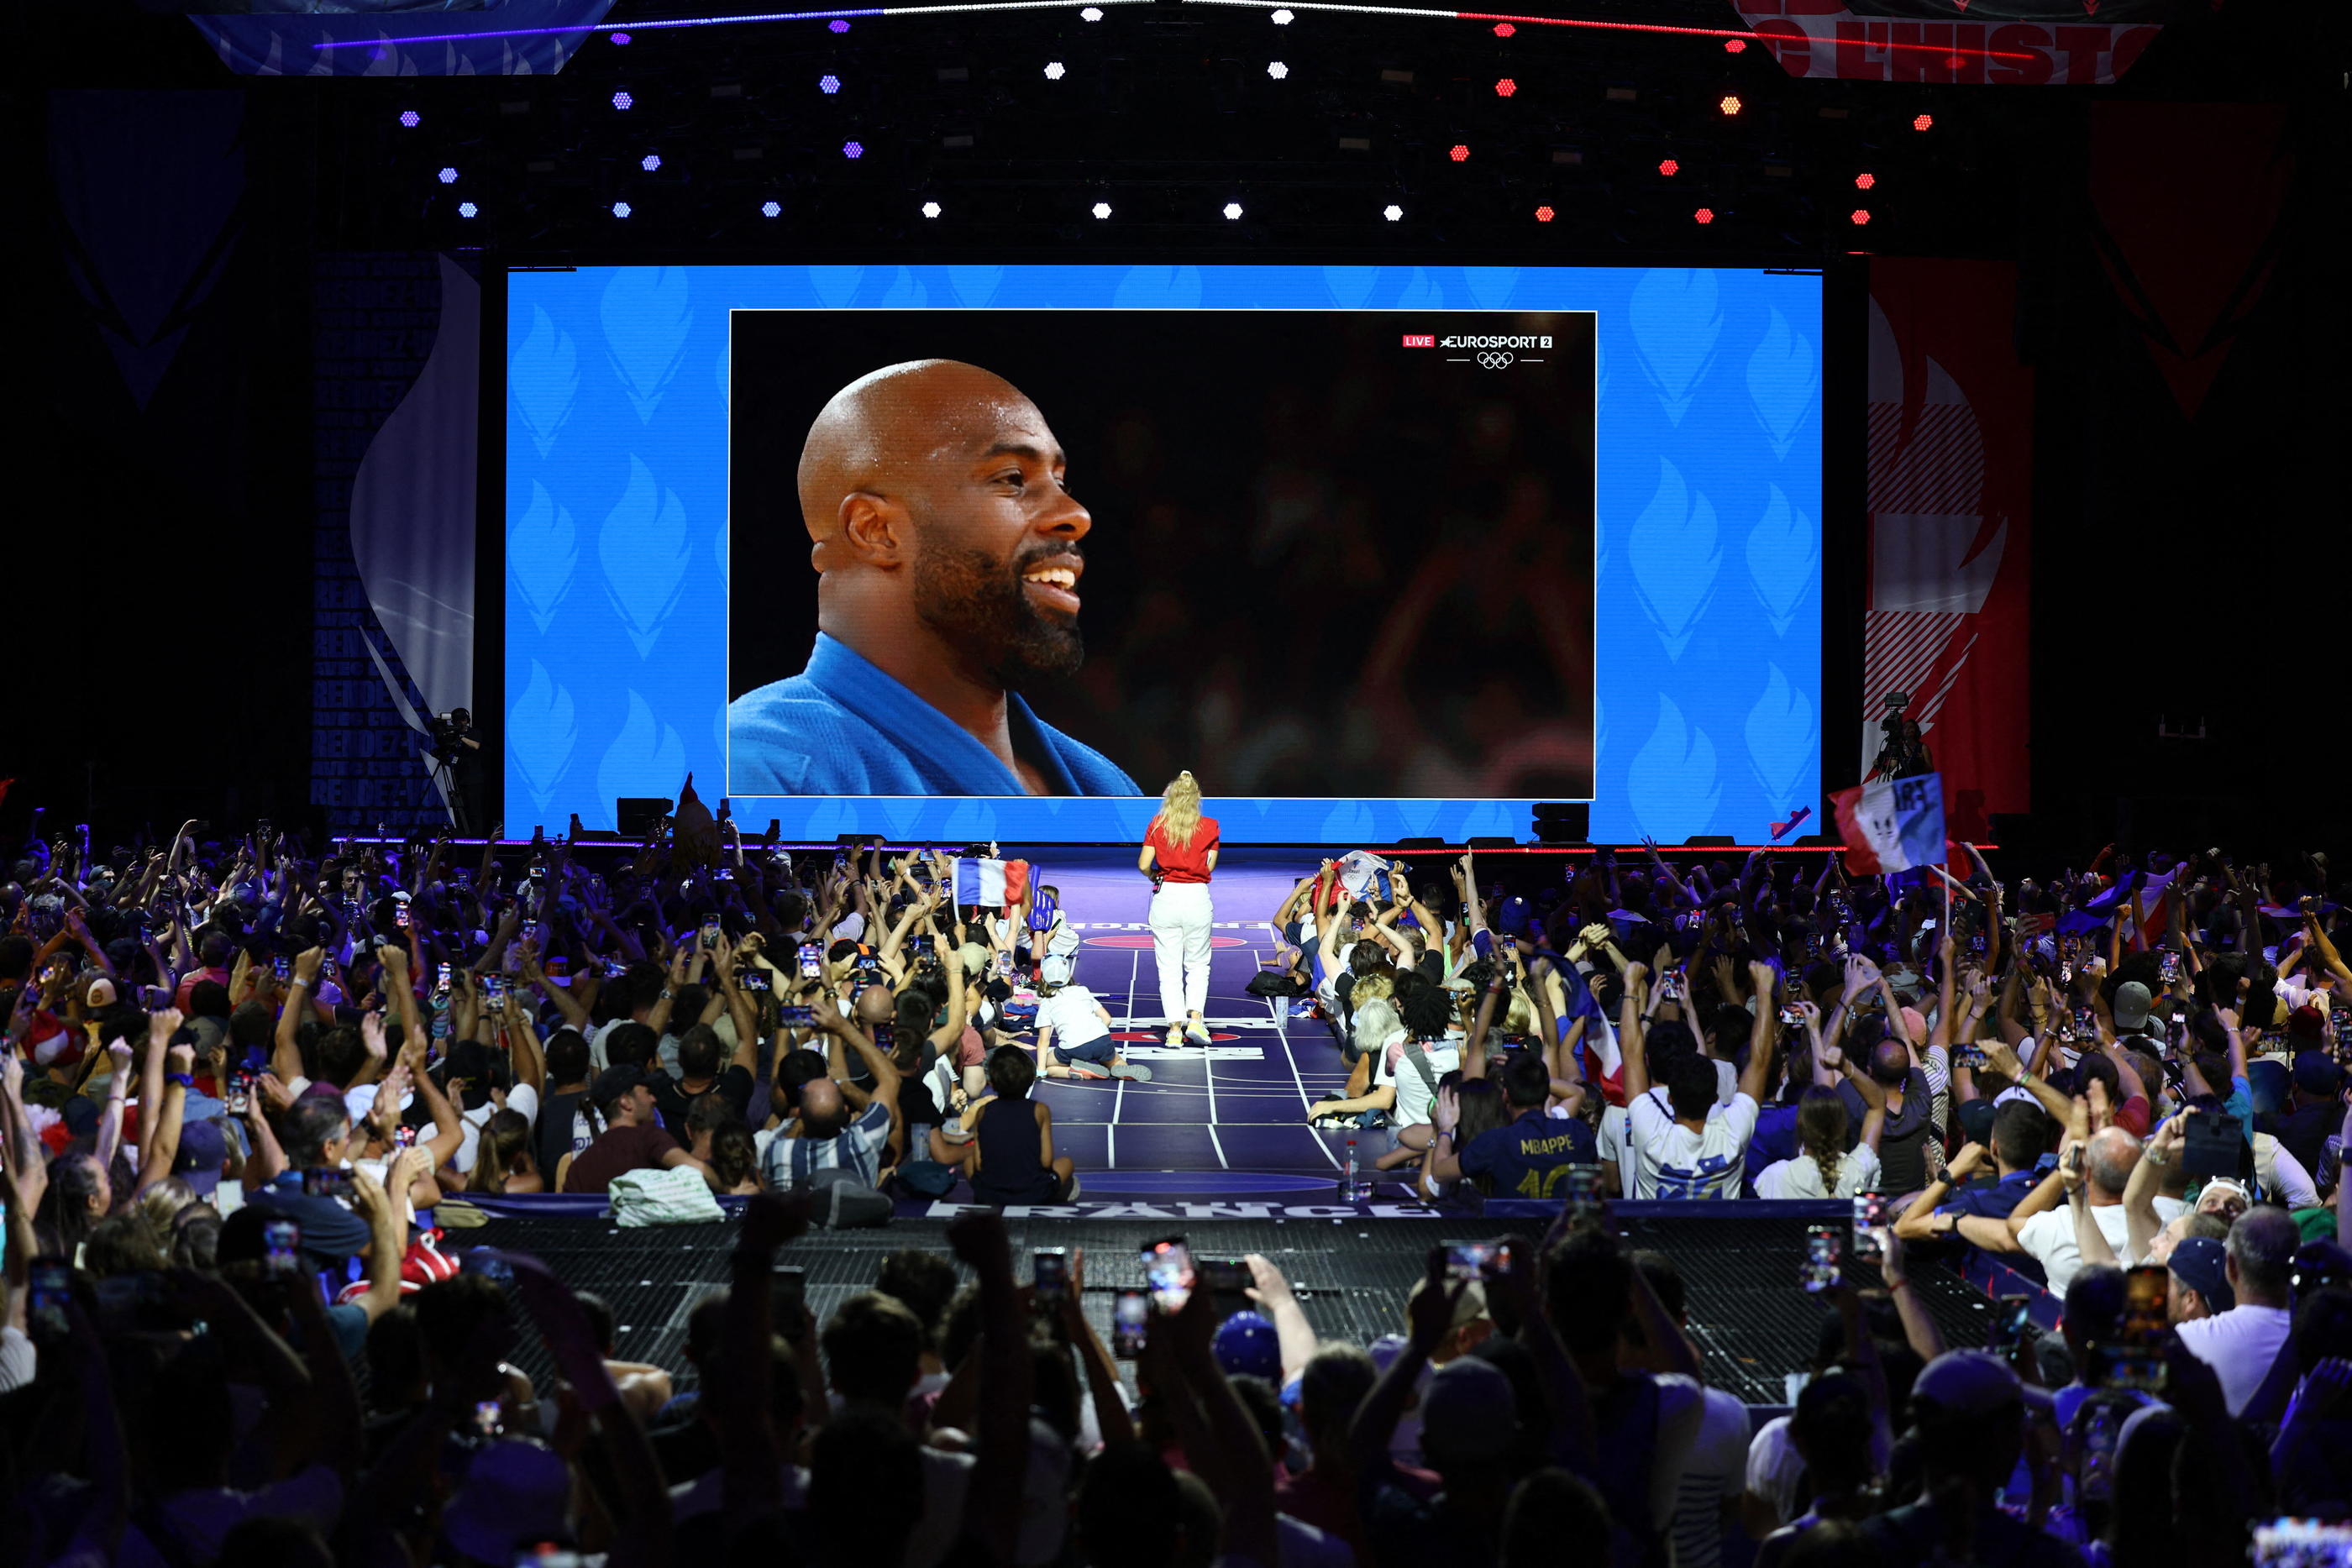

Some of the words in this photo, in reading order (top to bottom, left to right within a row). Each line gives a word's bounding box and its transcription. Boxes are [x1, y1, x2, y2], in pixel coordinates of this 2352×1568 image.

[1405, 336, 1431, 346] LIVE
[1441, 335, 1538, 349] EUROSPORT
[1067, 922, 1273, 931] FRNCE
[1520, 1133, 1574, 1156] MBAPPE
[925, 1201, 1441, 1217] FRANCE
